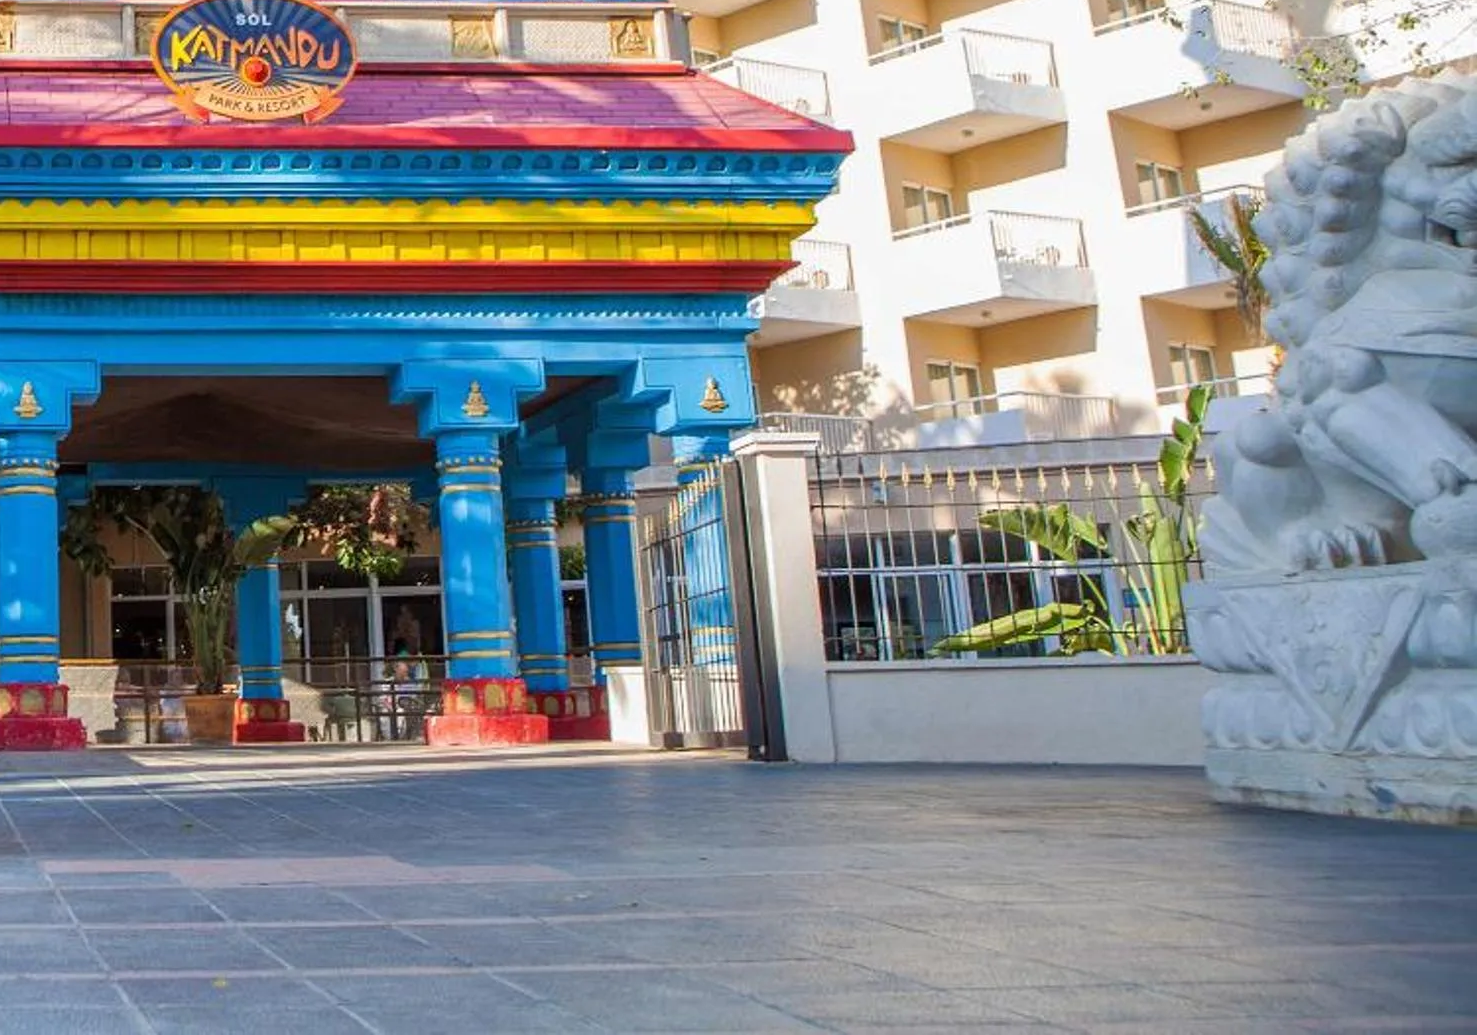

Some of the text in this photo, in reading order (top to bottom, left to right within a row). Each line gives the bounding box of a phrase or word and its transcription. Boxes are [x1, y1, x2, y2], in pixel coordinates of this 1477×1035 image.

[235, 13, 272, 26] SOL
[170, 23, 340, 71] KATMANDU
[208, 92, 307, 113] PARK & RESORT
